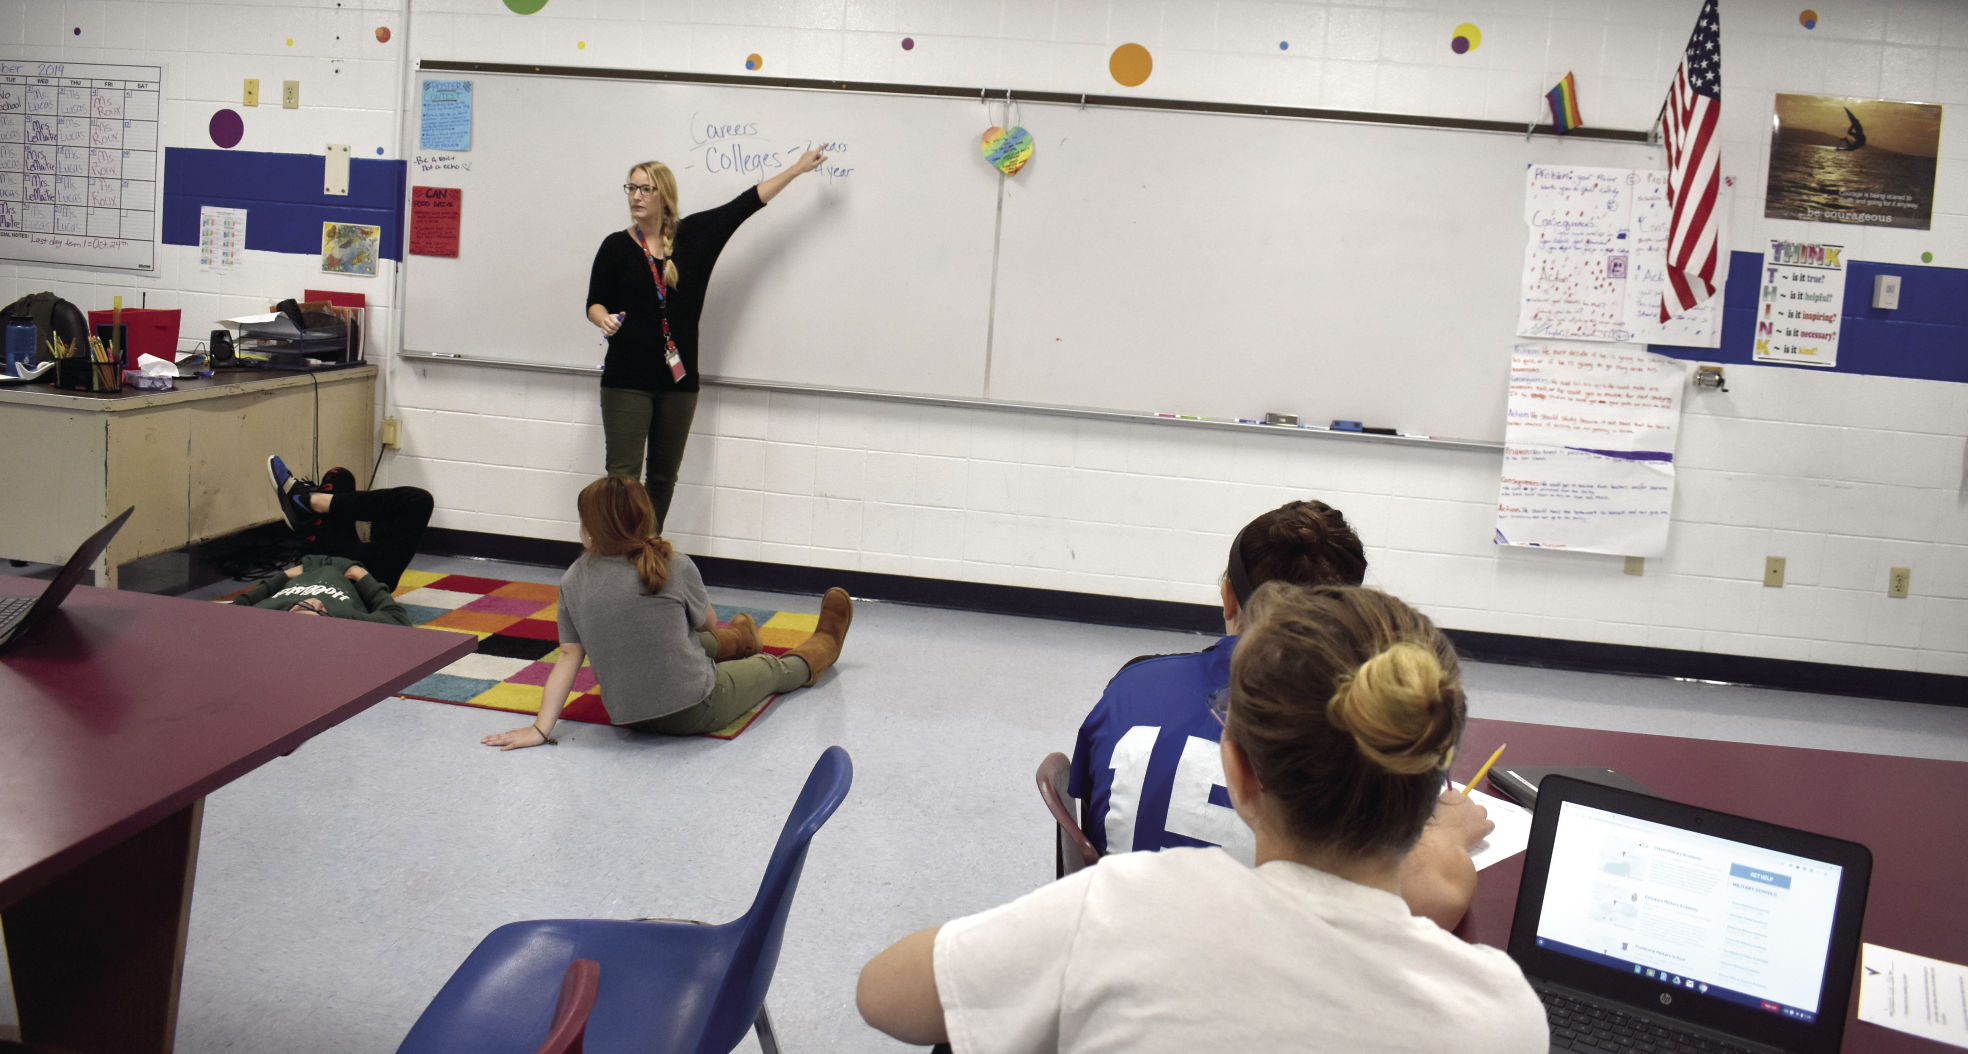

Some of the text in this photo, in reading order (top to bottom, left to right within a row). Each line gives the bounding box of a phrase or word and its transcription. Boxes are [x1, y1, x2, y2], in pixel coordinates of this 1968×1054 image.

[0, 63, 65, 77] ber 2019
[0, 96, 21, 111] chool
[690, 112, 759, 145] Careers
[705, 143, 782, 184] Colleges
[814, 163, 854, 184] 4 year
[1647, 172, 1668, 185] Prob
[426, 188, 448, 199] CAN
[1864, 191, 1868, 199] is
[1867, 200, 1882, 208] going
[0, 214, 20, 229] Maitre
[1807, 207, 1893, 223] be courageous
[30, 234, 48, 244] Last
[49, 237, 63, 249] day
[65, 240, 82, 248] term
[1772, 243, 1841, 267] THINK
[1767, 268, 1825, 284] T is it true?
[1763, 285, 1777, 302] H
[1790, 290, 1796, 300] is
[1797, 291, 1803, 300] it
[1764, 303, 1837, 323] I is it inspiring?
[1759, 321, 1837, 341] N is it necessary?
[1756, 338, 1770, 355] K
[1783, 344, 1790, 354] is
[1791, 345, 1797, 354] it
[1750, 872, 1774, 883] GET HELP
[1661, 993, 1672, 1005] hp
